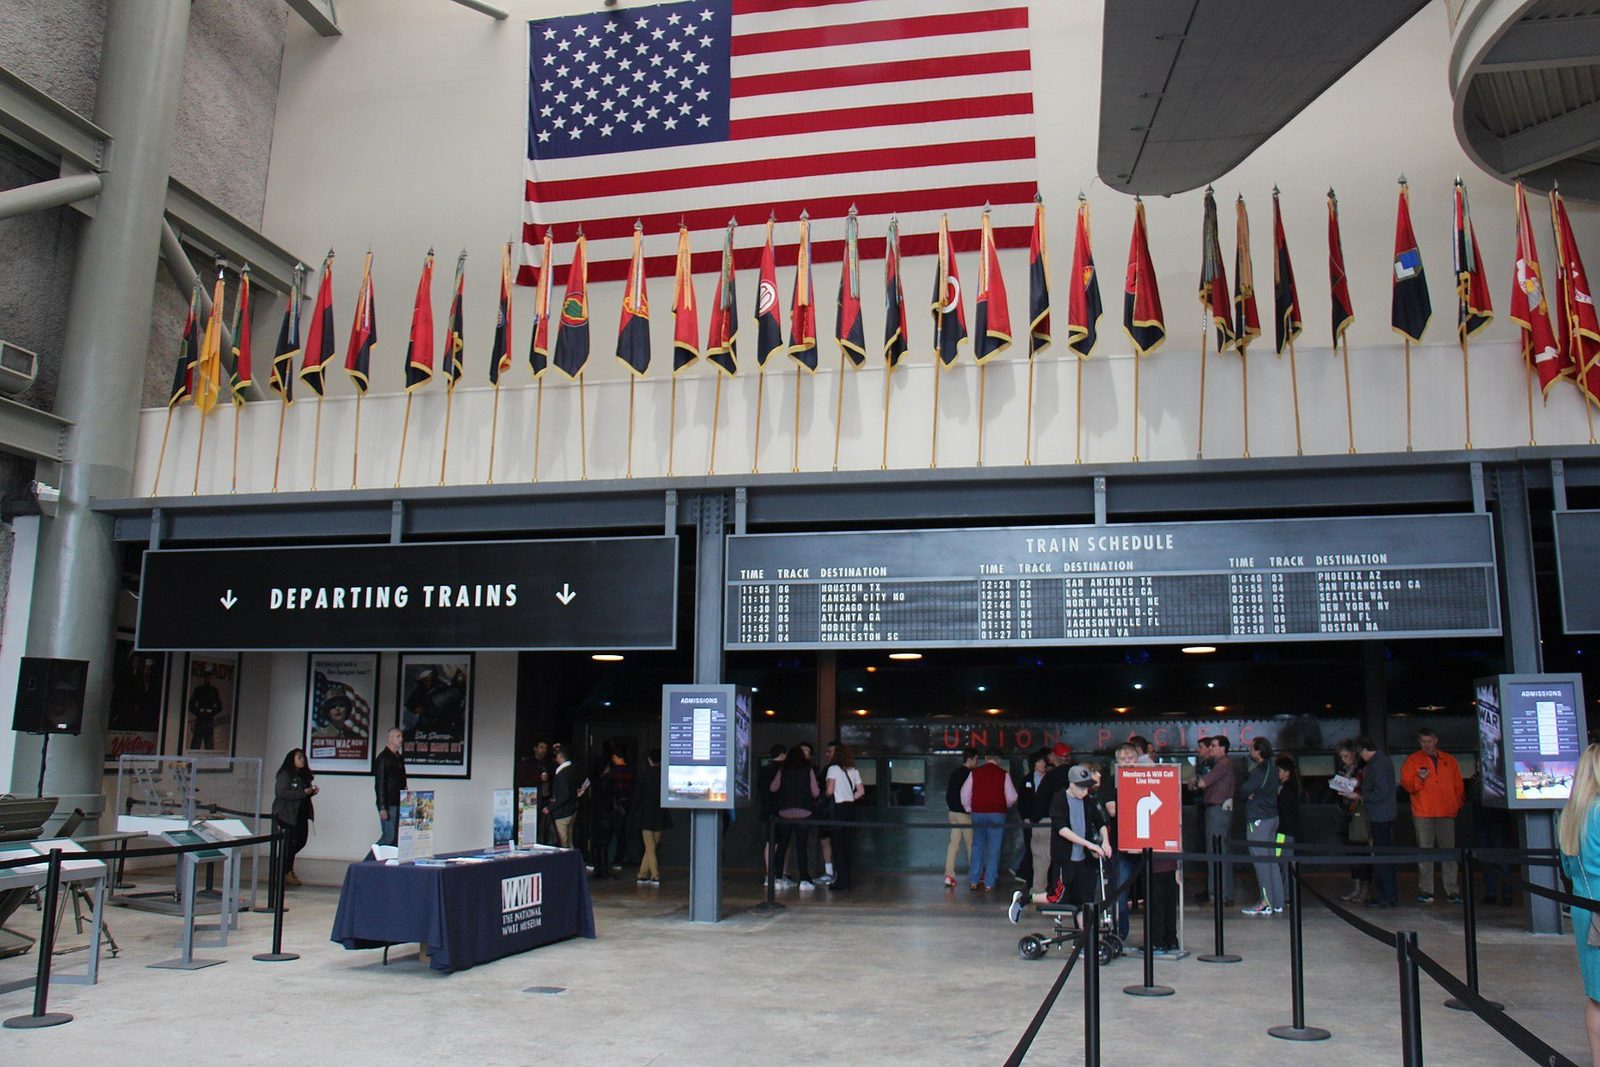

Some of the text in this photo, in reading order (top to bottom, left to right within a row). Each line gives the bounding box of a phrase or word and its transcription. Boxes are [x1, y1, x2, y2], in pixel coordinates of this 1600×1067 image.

[1026, 534, 1174, 553] TRAIN SCHEDULE
[1229, 554, 1387, 568] TIME TRACK DESTINATION
[741, 567, 887, 579] TIME TRACK DESTINATION
[980, 561, 1133, 574] TIME TRACK DESTINATION
[982, 577, 1152, 589] 12:20 02 SAN ANTONIO TX
[1232, 571, 1381, 583] 01:40 03 PHOENIX AZ
[742, 586, 770, 594] 11:05
[778, 585, 789, 593] 06
[822, 584, 862, 592] HOUSTON
[1232, 580, 1420, 593] 01:55 04 SAN FRANCISCO CA
[270, 583, 518, 610] DEPARTING TRAINS
[742, 595, 769, 603] 11:18
[778, 595, 789, 603] 02
[822, 594, 857, 602] KANSAS
[864, 593, 886, 601] CITY
[982, 587, 1152, 599] 12:33 03 LOS ANGELES CA
[1273, 594, 1284, 602] 02
[1320, 592, 1363, 601] SEATTLE
[1370, 592, 1383, 600] WA
[742, 603, 880, 613] 11:30 03 CHICAGO IL
[1020, 600, 1031, 608] 06
[1066, 599, 1096, 607] NORTH
[1104, 598, 1140, 606] PLATTE
[1148, 597, 1159, 605] NE
[1233, 602, 1389, 614] 02:24 01 NEW YORK NY
[742, 613, 880, 623] 11:42 05 ATLANTA GA
[1021, 610, 1031, 618] 04
[1066, 608, 1128, 617] WASHINGTON
[1135, 608, 1158, 616] D.C.
[1320, 613, 1351, 622] MIAMI
[742, 623, 874, 632] 11:55 01 MOBILE AL
[982, 621, 1011, 629] 01:12
[1021, 620, 1032, 628] 05
[1067, 618, 1140, 627] JACKSONVILLE
[1234, 623, 1378, 634] 02:50 05 BOSTON MA
[742, 634, 769, 642] 12:07
[778, 634, 789, 642] 04
[822, 633, 880, 641] CHARLESTON
[982, 628, 1129, 639] 01:27 01 NORFOLK VA
[1478, 706, 1498, 729] WAR
[942, 728, 1060, 749] UNION
[112, 734, 155, 758] Victory
[502, 872, 542, 912] WWII
[503, 906, 542, 925] THE NATIONAL
[502, 918, 542, 936] WWII MUSEUM
